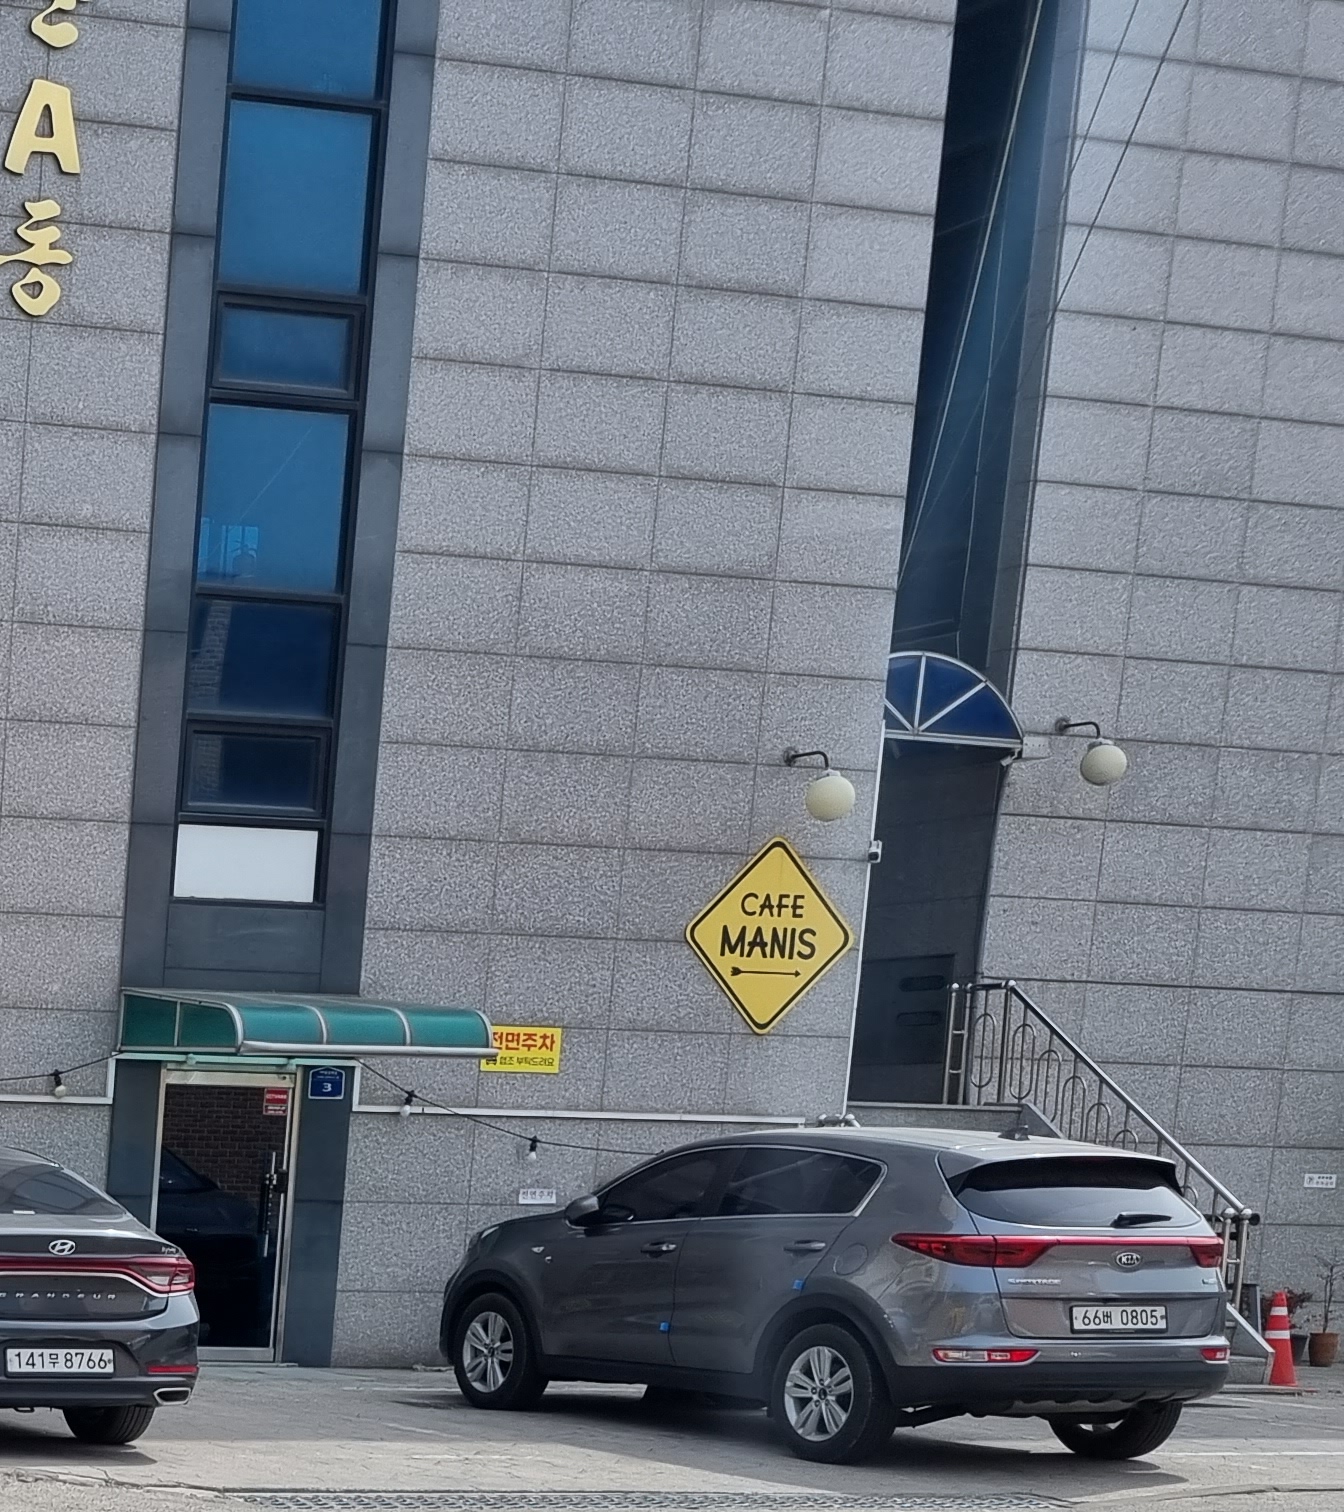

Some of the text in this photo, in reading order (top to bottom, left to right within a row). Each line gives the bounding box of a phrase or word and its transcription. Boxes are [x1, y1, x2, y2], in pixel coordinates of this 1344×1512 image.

[740, 892, 806, 919] CAFE
[719, 924, 817, 961] MANIS
[492, 1031, 556, 1053] 전면주차
[321, 1082, 333, 1093] 3
[1081, 1309, 1159, 1327] 66버 0805
[14, 1351, 108, 1370] 141무 8766
